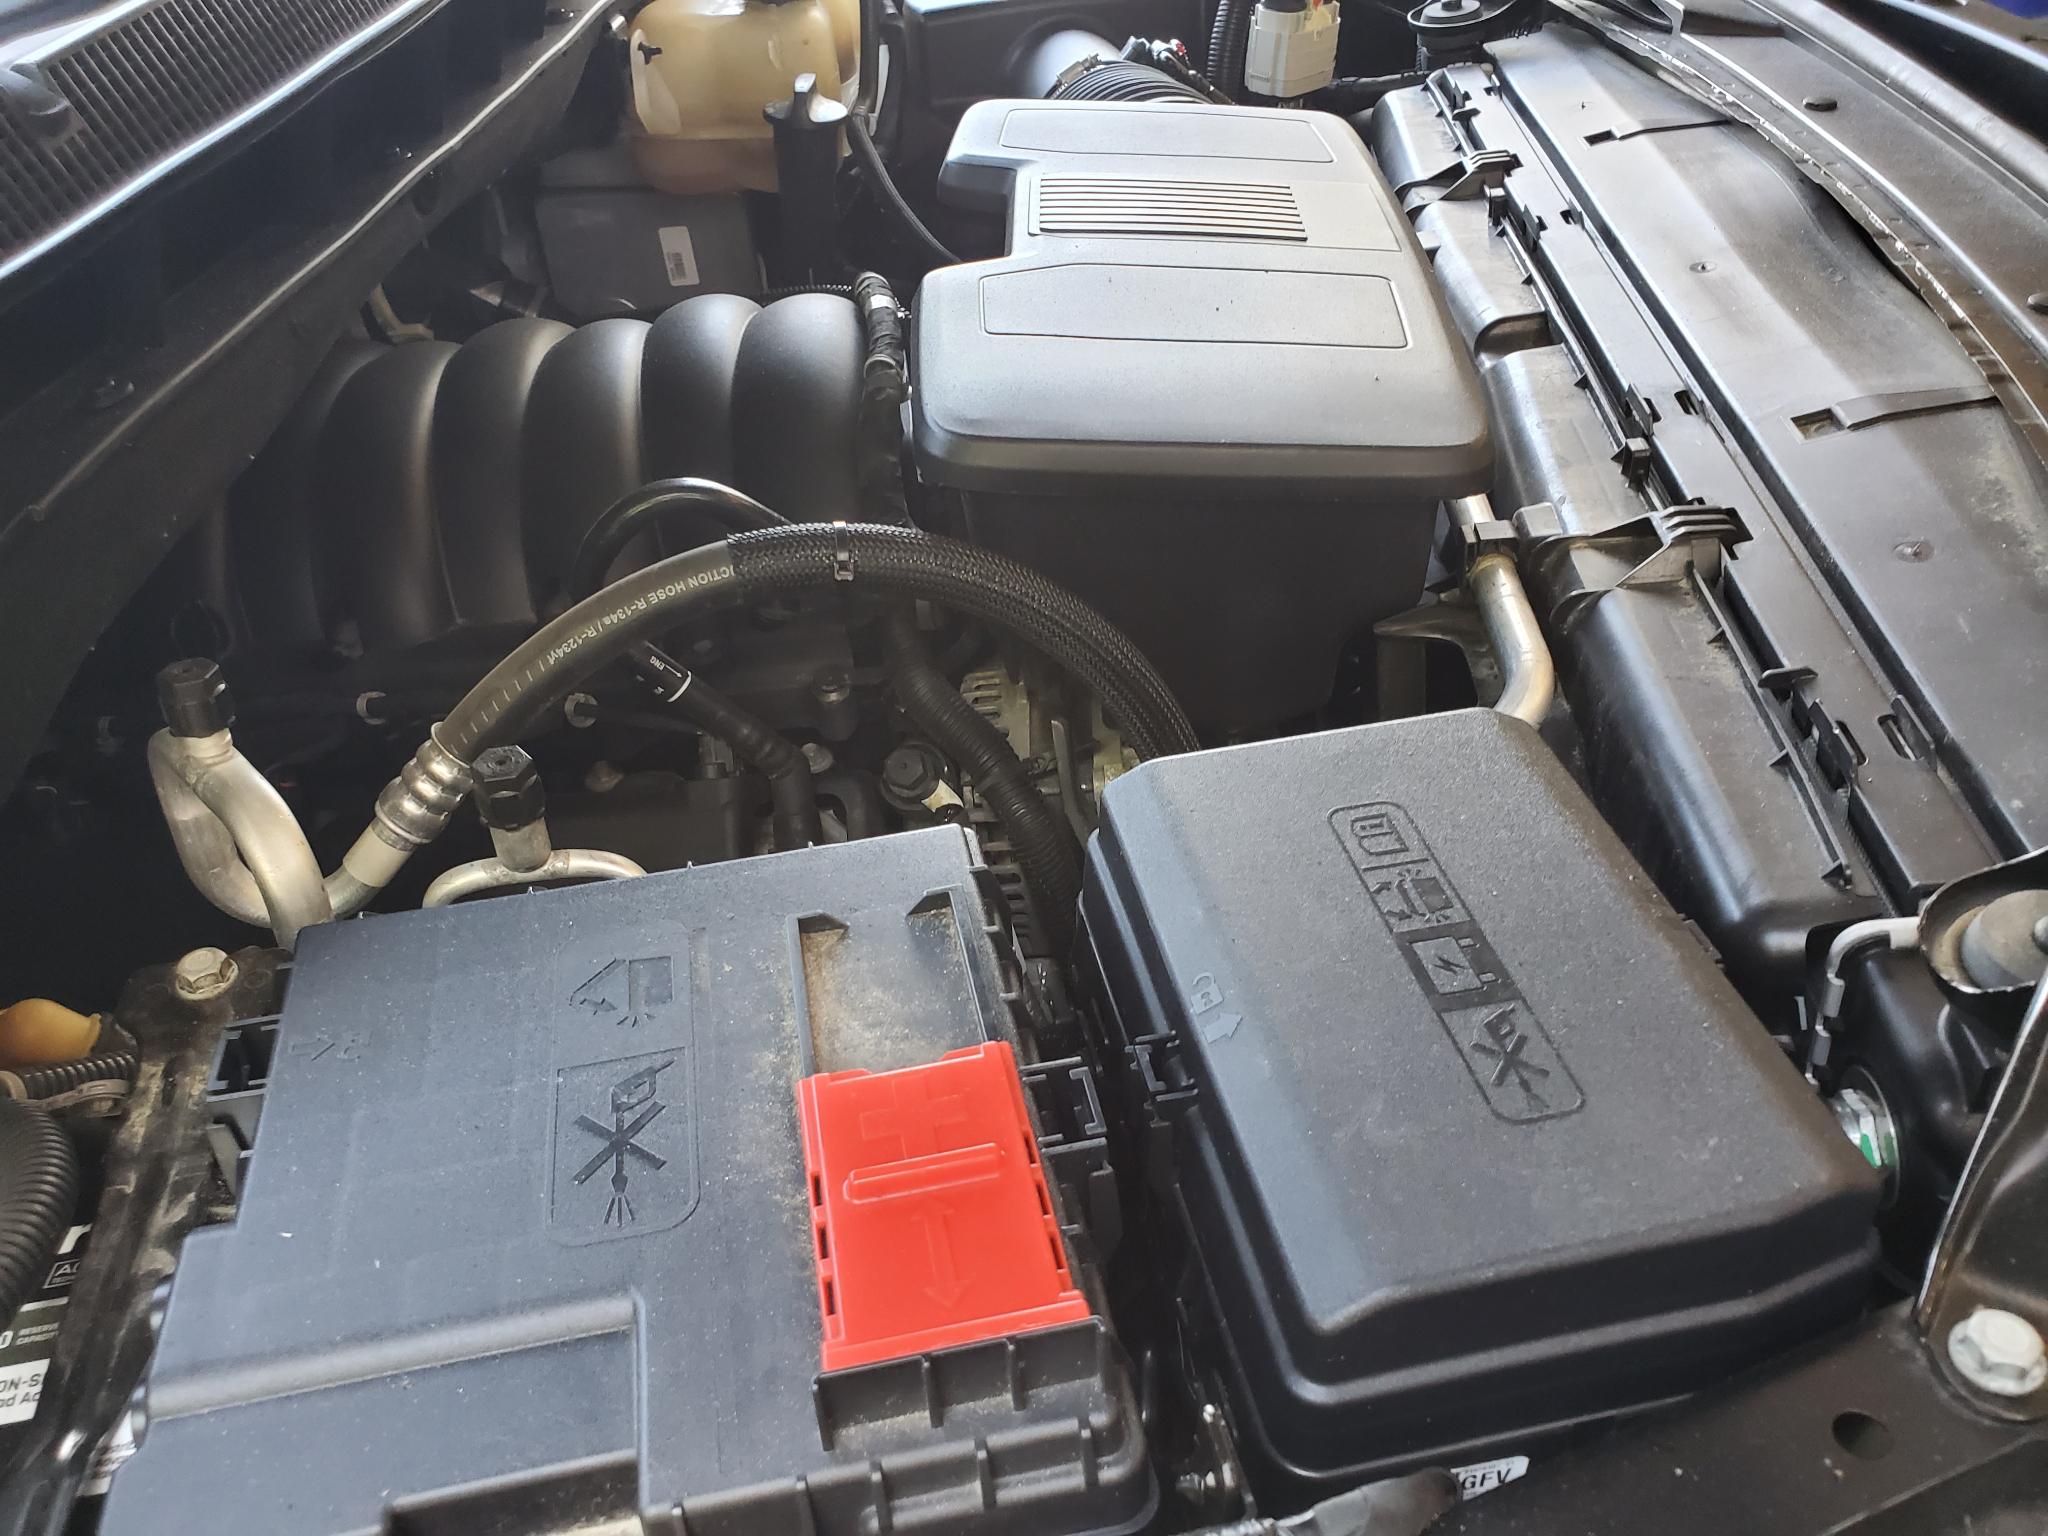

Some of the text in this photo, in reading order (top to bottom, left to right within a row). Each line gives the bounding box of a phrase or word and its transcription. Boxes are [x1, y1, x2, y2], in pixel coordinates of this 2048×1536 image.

[647, 580, 686, 604] HOSE
[602, 597, 647, 626] R-134a
[1455, 1468, 1511, 1491] GFV
